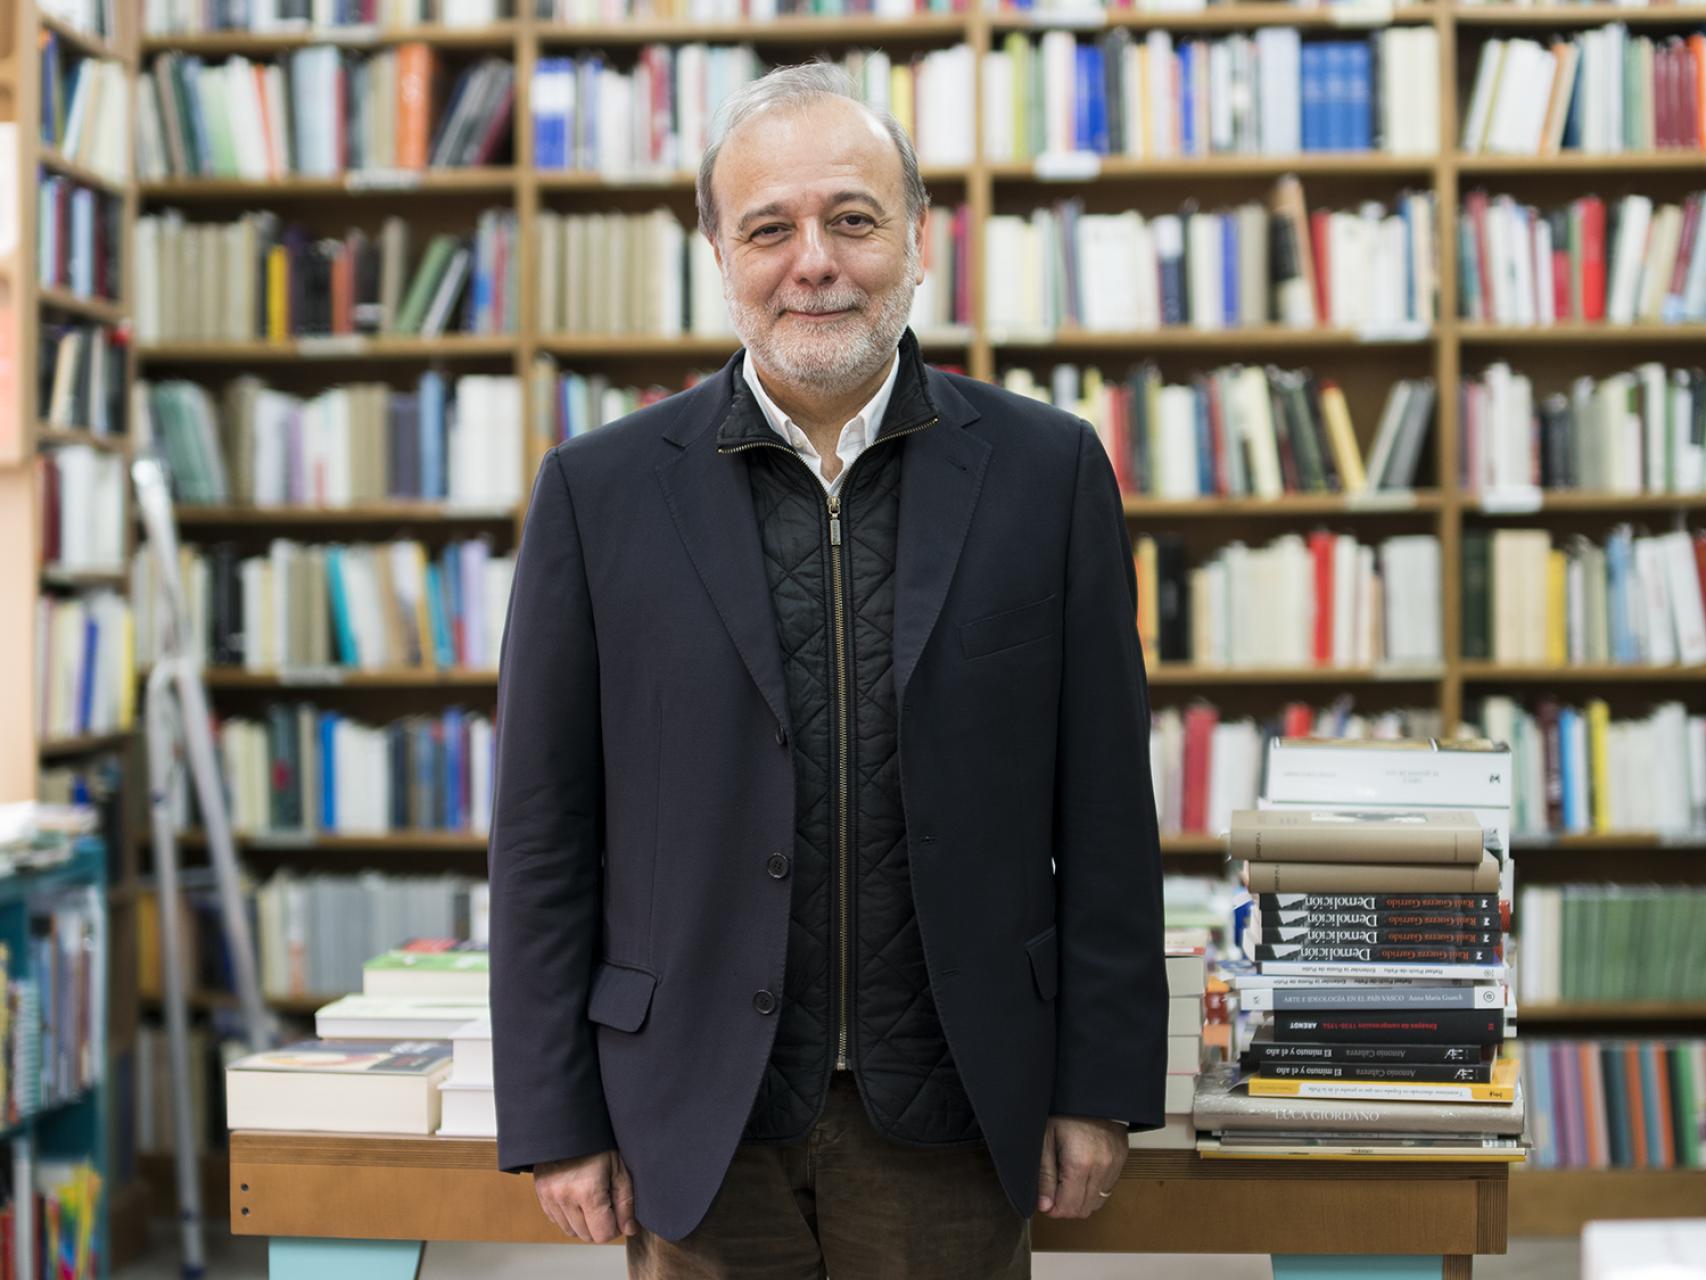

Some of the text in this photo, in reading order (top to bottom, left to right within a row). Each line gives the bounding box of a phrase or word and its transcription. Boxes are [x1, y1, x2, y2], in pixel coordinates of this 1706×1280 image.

[1305, 896, 1376, 910] Demolición
[1386, 899, 1420, 908] Garrido
[1307, 914, 1377, 927] Demolición
[1389, 917, 1423, 925] Garrido
[1307, 931, 1377, 944] Demolición
[1389, 934, 1422, 942] Garrido
[1301, 948, 1371, 960] Demolición
[1382, 951, 1415, 959] Garrido
[1266, 1048, 1280, 1056] año
[1281, 1048, 1289, 1056] el
[1290, 1047, 1295, 1055] y
[1324, 1049, 1332, 1057] El
[1376, 1050, 1405, 1058] Antonio
[1276, 1067, 1289, 1075] año
[1292, 1067, 1299, 1075] el
[1334, 1068, 1342, 1076] El
[1386, 1069, 1416, 1077] Antonio
[1275, 1109, 1379, 1121] LUCA GIORDANO
